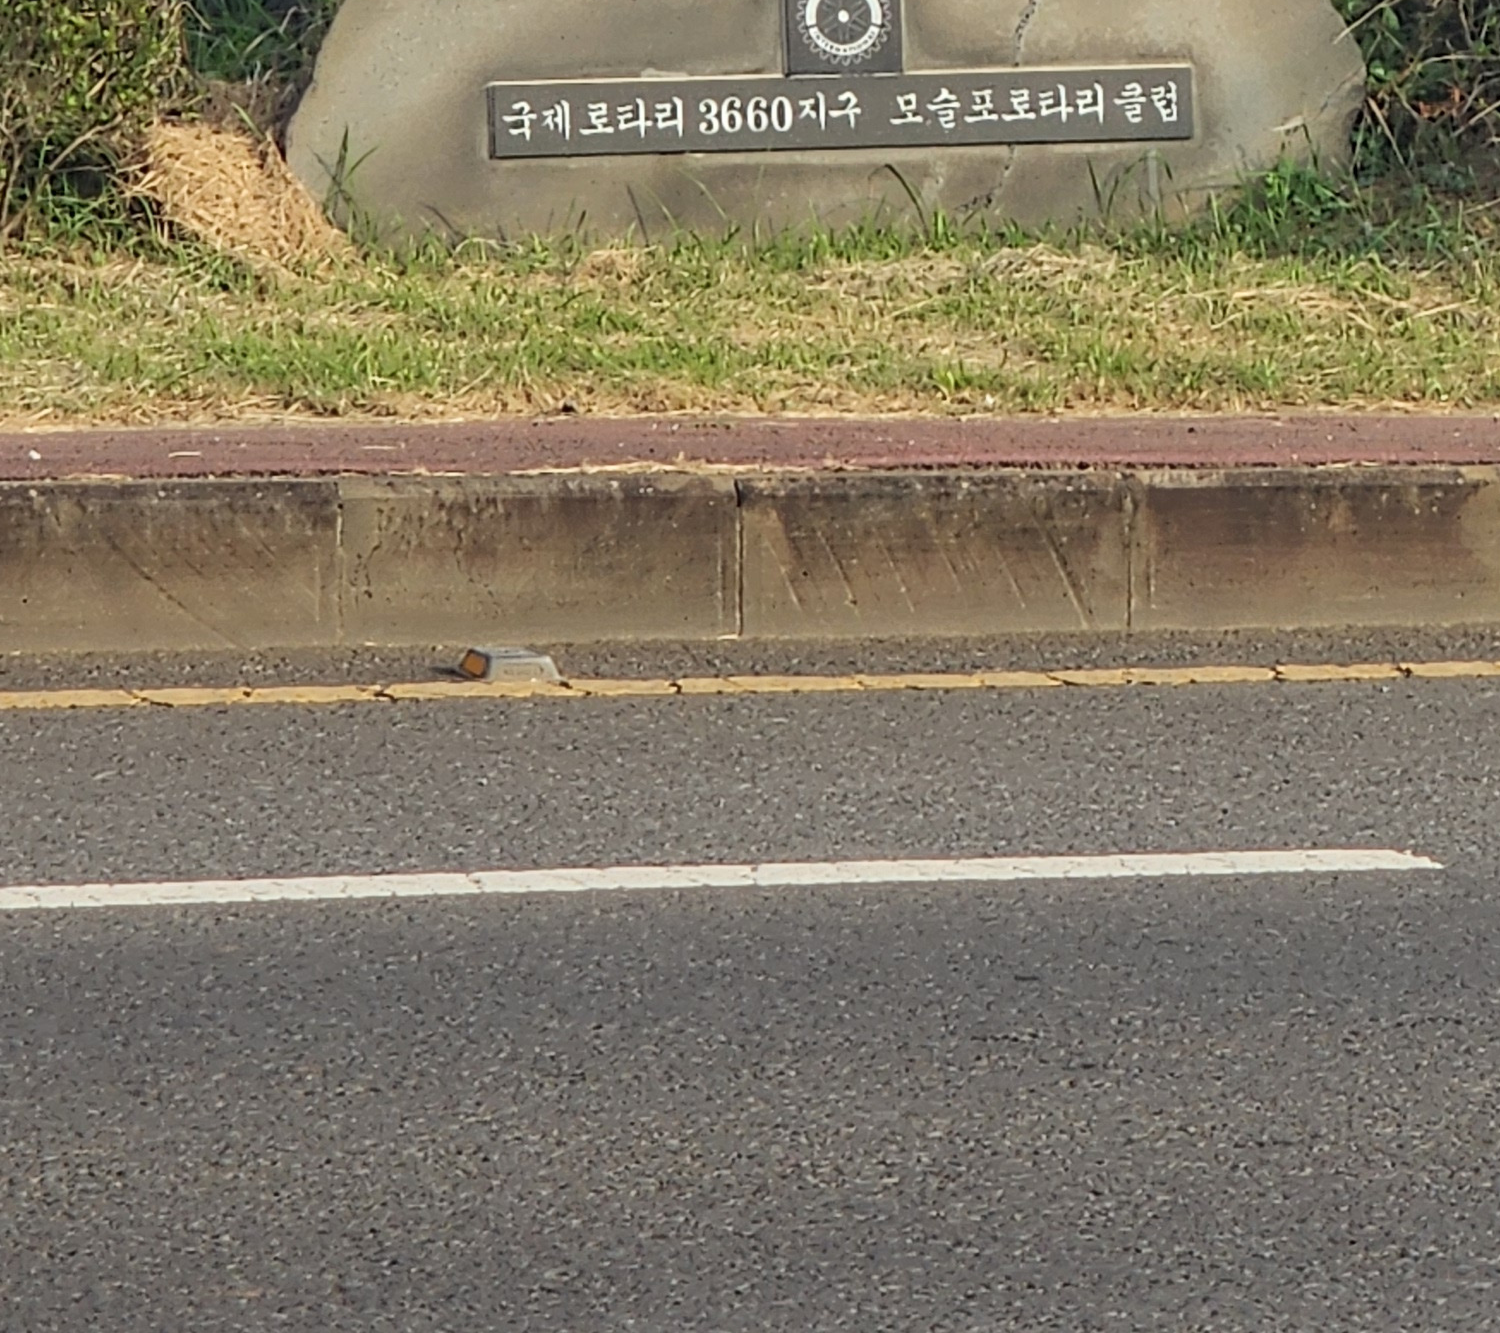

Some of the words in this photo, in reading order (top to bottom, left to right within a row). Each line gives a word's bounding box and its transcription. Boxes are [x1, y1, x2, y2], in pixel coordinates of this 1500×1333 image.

[502, 99, 571, 141] 국제
[579, 96, 684, 138] 로타리
[889, 82, 1105, 128] 모슬포로타리
[1113, 80, 1178, 125] 클럽
